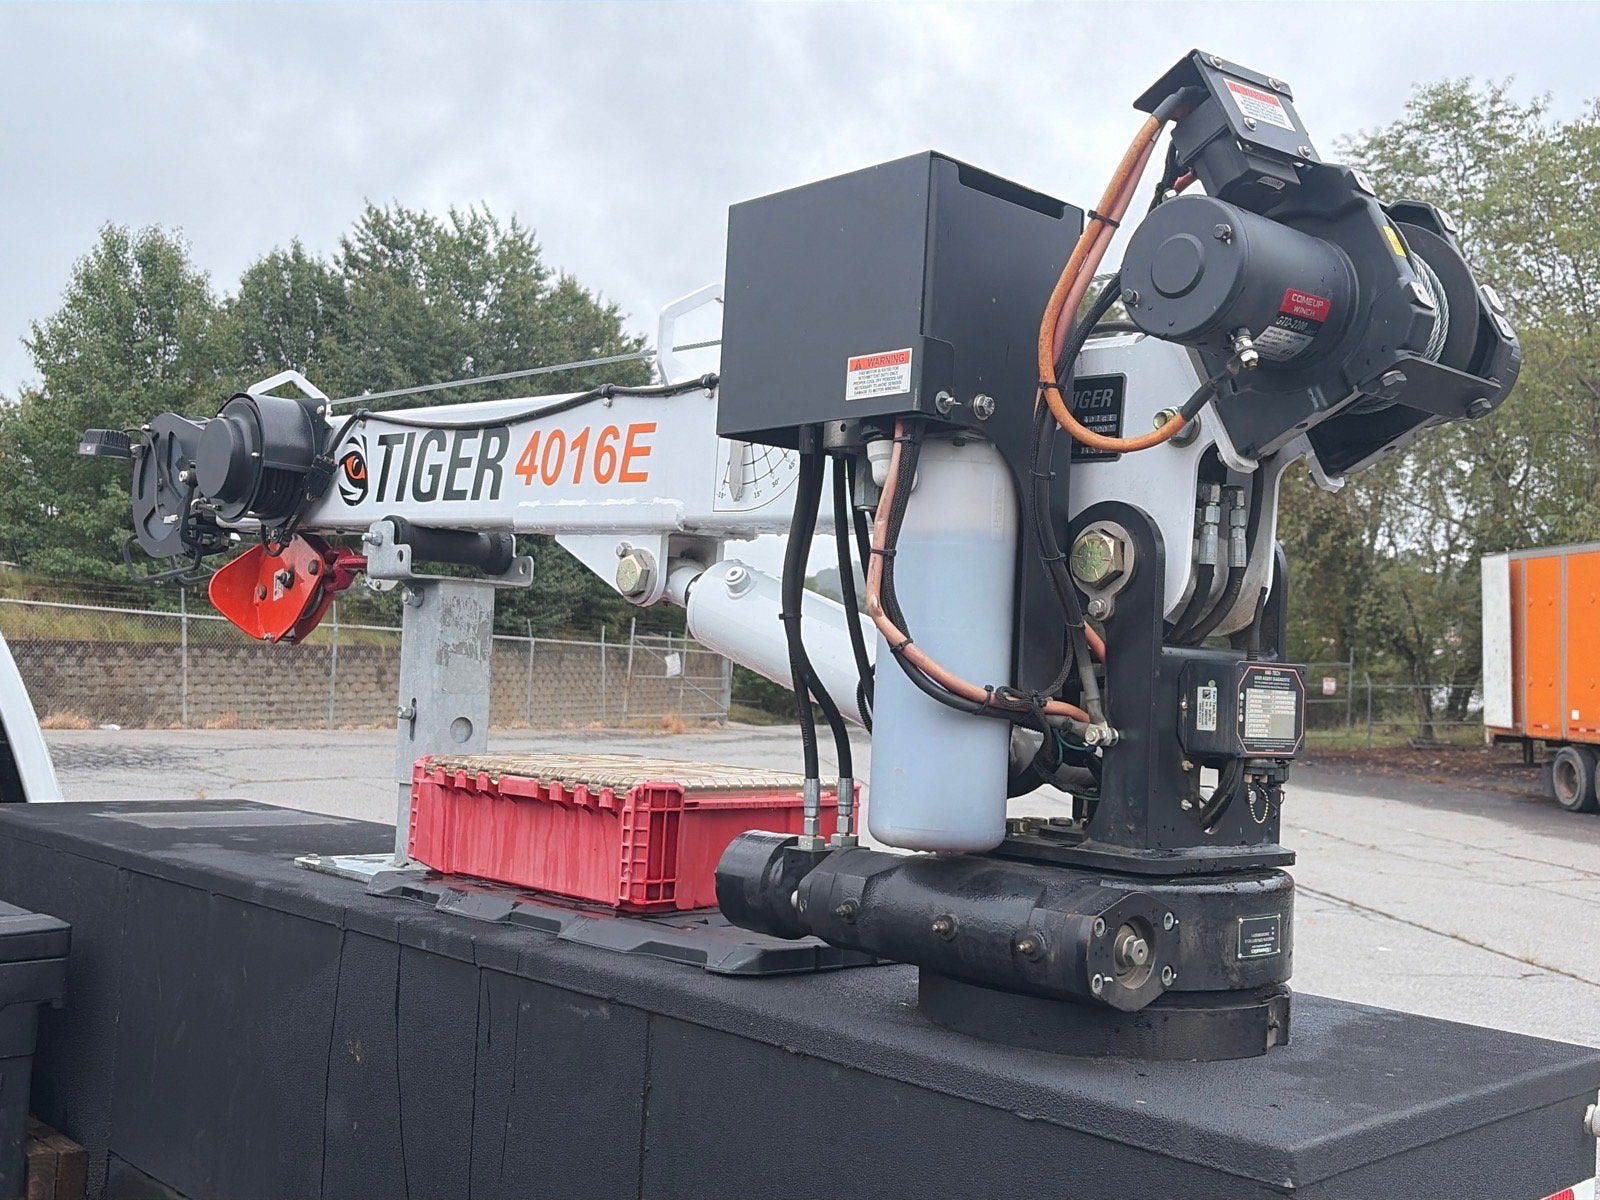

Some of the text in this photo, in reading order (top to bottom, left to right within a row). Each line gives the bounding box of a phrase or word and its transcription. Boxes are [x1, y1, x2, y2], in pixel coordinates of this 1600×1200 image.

[1292, 293, 1323, 308] COMEUP
[1293, 305, 1316, 317] WINCH
[867, 353, 904, 367] WARNING
[1073, 388, 1114, 409] IGER
[375, 422, 657, 503] TIGER 4016E
